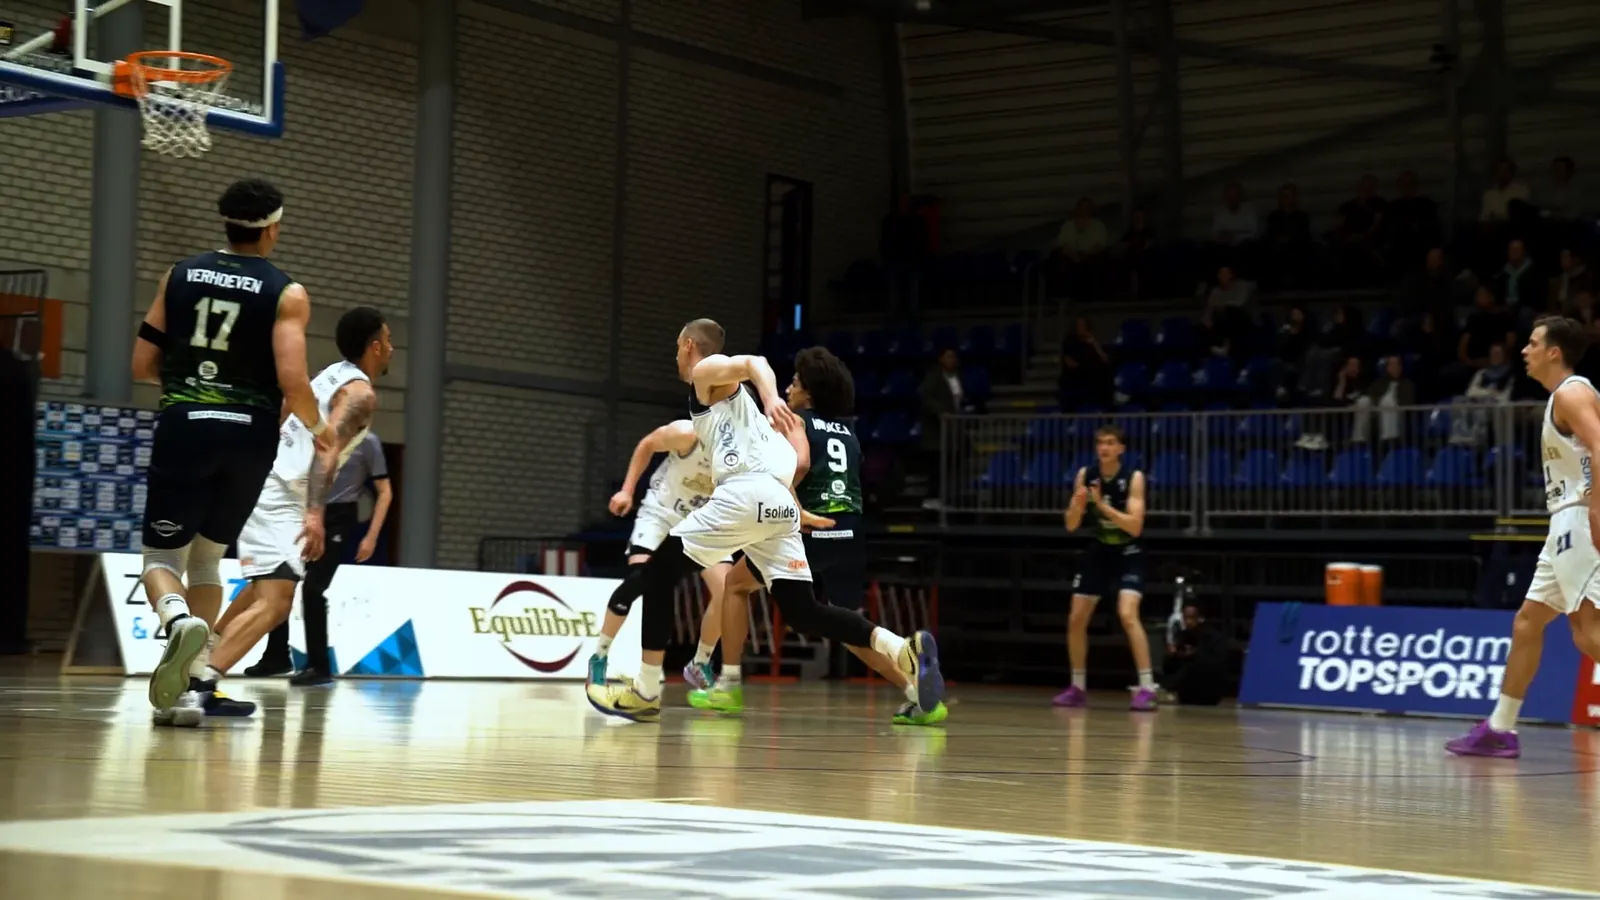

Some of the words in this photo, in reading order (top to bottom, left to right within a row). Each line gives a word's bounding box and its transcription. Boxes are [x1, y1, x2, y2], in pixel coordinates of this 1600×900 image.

[186, 268, 263, 294] VERHOEVEN
[189, 297, 241, 351] 17
[827, 438, 848, 473] 9
[468, 606, 601, 642] EquilibrE
[1300, 625, 1512, 662] rotterdam
[1298, 656, 1508, 700] TOPSPORT
